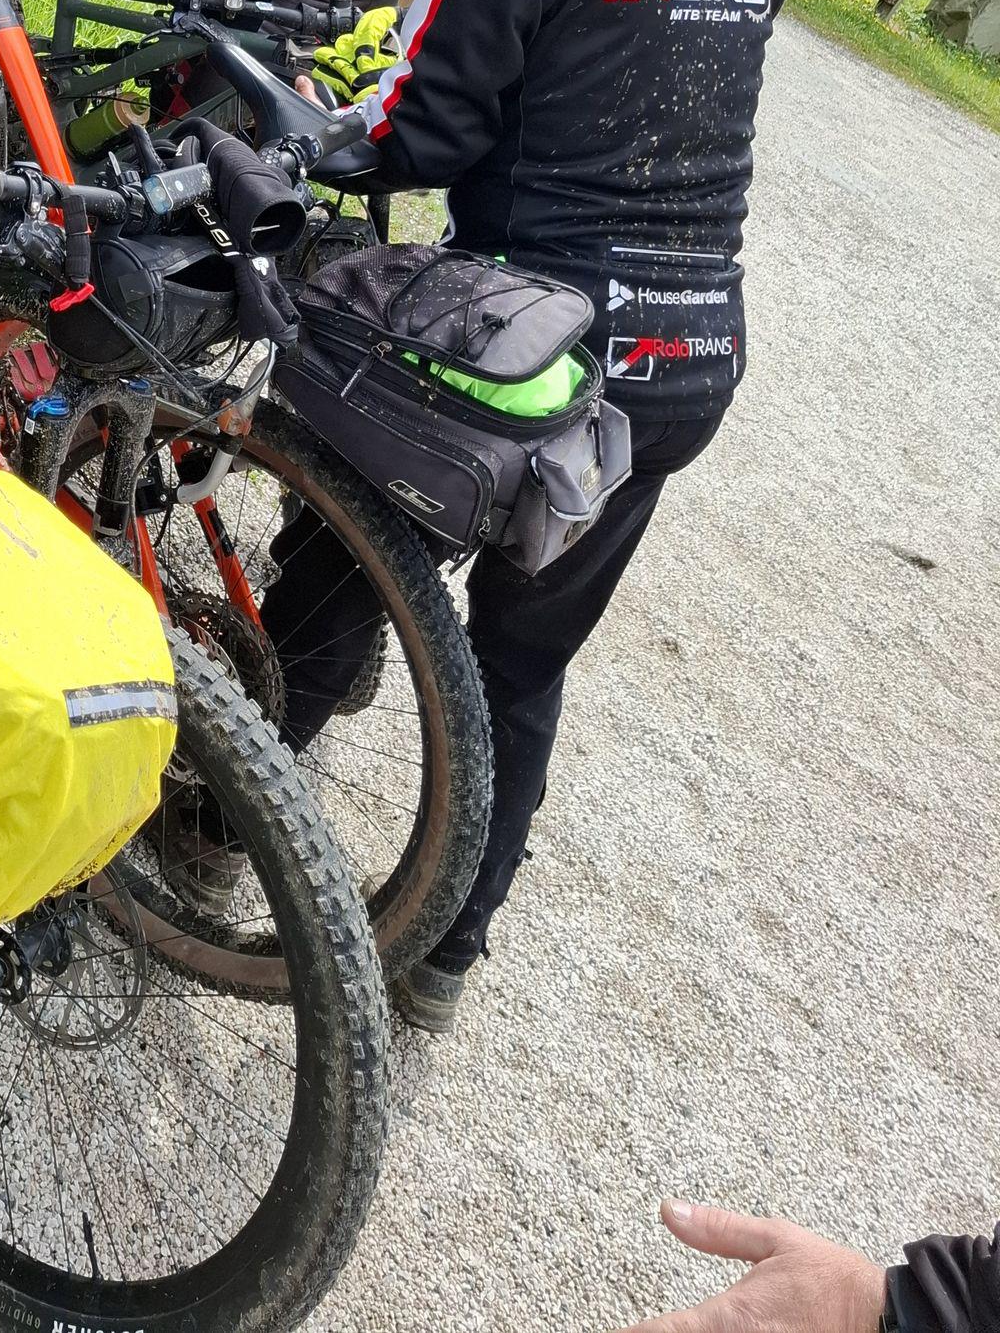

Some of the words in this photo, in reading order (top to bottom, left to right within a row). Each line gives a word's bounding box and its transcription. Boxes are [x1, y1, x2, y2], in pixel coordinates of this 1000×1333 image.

[669, 8, 700, 21] MTB
[704, 9, 741, 22] TEAM
[638, 287, 728, 305] HouseGarden
